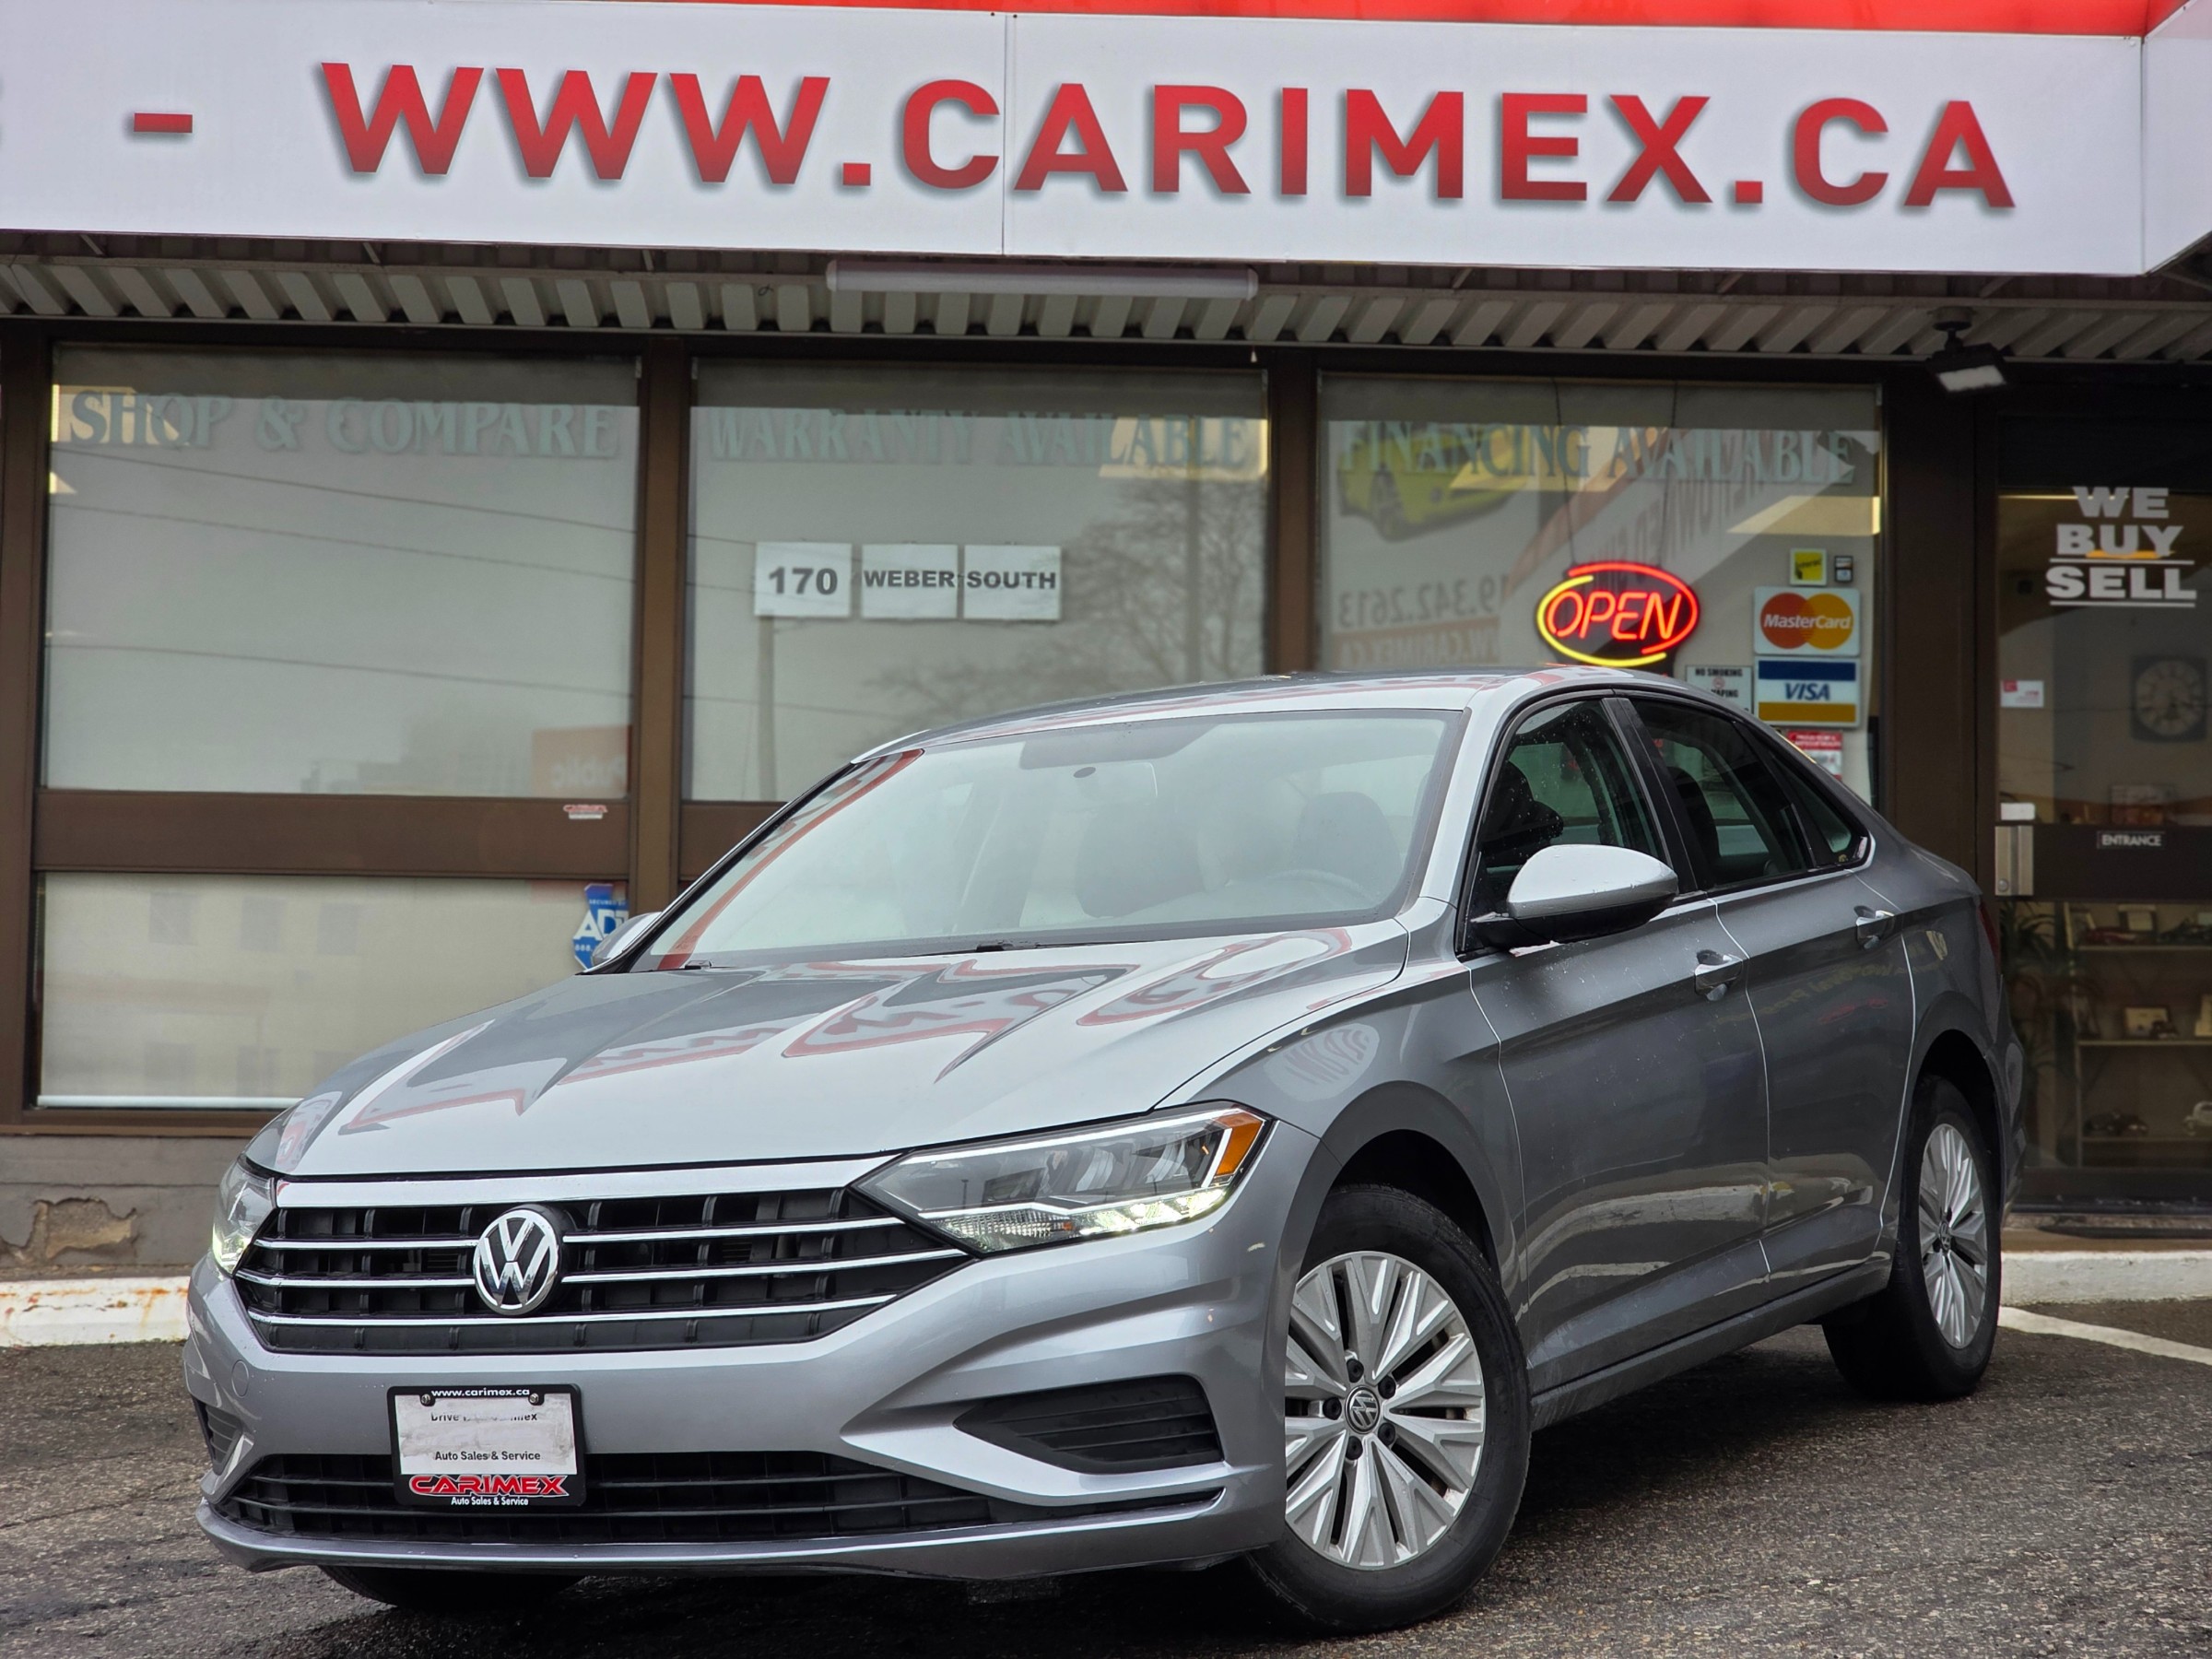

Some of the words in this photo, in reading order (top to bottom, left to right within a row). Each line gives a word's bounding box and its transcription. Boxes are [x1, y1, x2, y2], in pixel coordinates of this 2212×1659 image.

[320, 62, 2016, 208] WWW.CARIMEX.CA
[69, 388, 231, 447] SHOP
[255, 394, 307, 453] &
[327, 396, 621, 459] COMPARE
[708, 407, 979, 464] WARRANTY
[1000, 411, 1250, 469] AVAILABLE
[1339, 421, 1591, 478] FINANCING
[1607, 425, 1854, 484] AVAILABLE
[2072, 486, 2171, 519] WE
[2056, 524, 2184, 557] BUY
[768, 567, 839, 595] 170
[864, 570, 956, 588] WEBER
[966, 571, 1057, 590] SOUTH
[2045, 567, 2197, 600] SELL
[1546, 591, 1683, 640] OPEN
[1763, 614, 1852, 629] MasterCard
[1784, 682, 1831, 701] VISA
[2101, 833, 2162, 847] ENTRANCE
[430, 1387, 531, 1397] www.carimex.ca
[434, 1451, 458, 1461] Auto
[460, 1451, 488, 1461] Sales
[492, 1451, 499, 1461] &
[501, 1451, 541, 1461] Service
[410, 1475, 568, 1496] CARIMEX
[451, 1496, 470, 1506] Auto
[471, 1496, 491, 1506] Sales
[493, 1496, 500, 1506] &
[501, 1496, 529, 1506] Service
